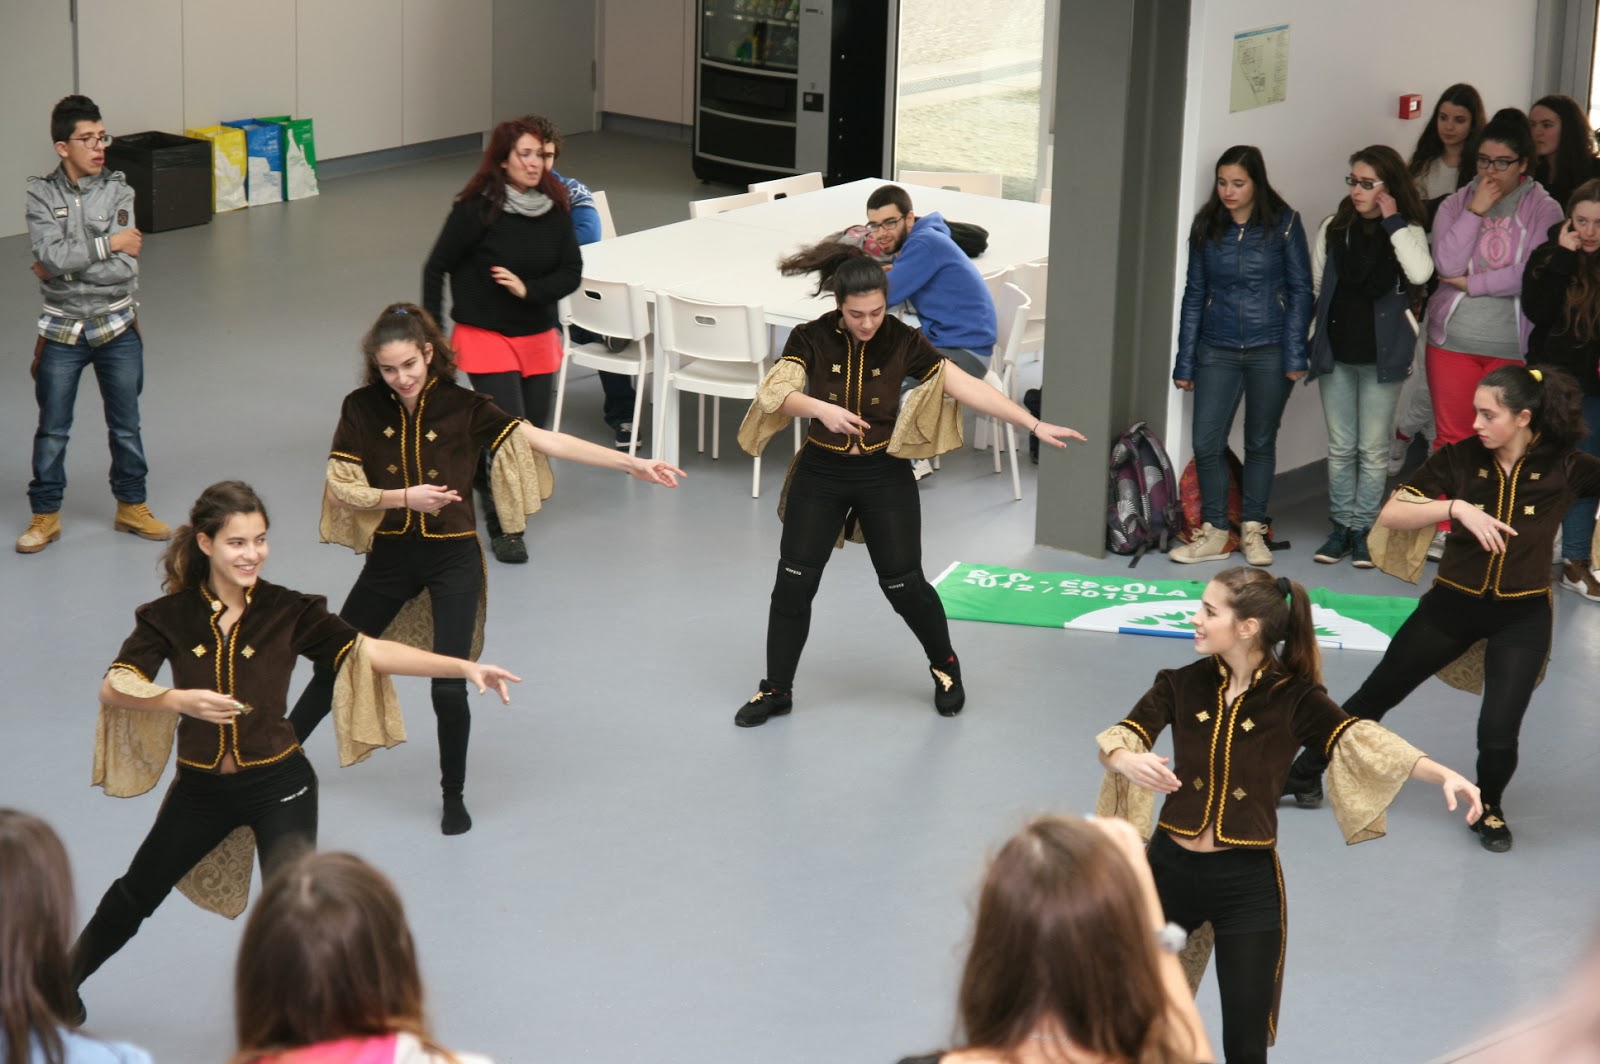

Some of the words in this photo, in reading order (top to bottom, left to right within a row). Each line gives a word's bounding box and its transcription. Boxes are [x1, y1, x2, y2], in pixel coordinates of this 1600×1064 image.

[967, 569, 1032, 583] EO
[1059, 579, 1188, 598] ESCOLA
[1060, 588, 1139, 601] 2013
